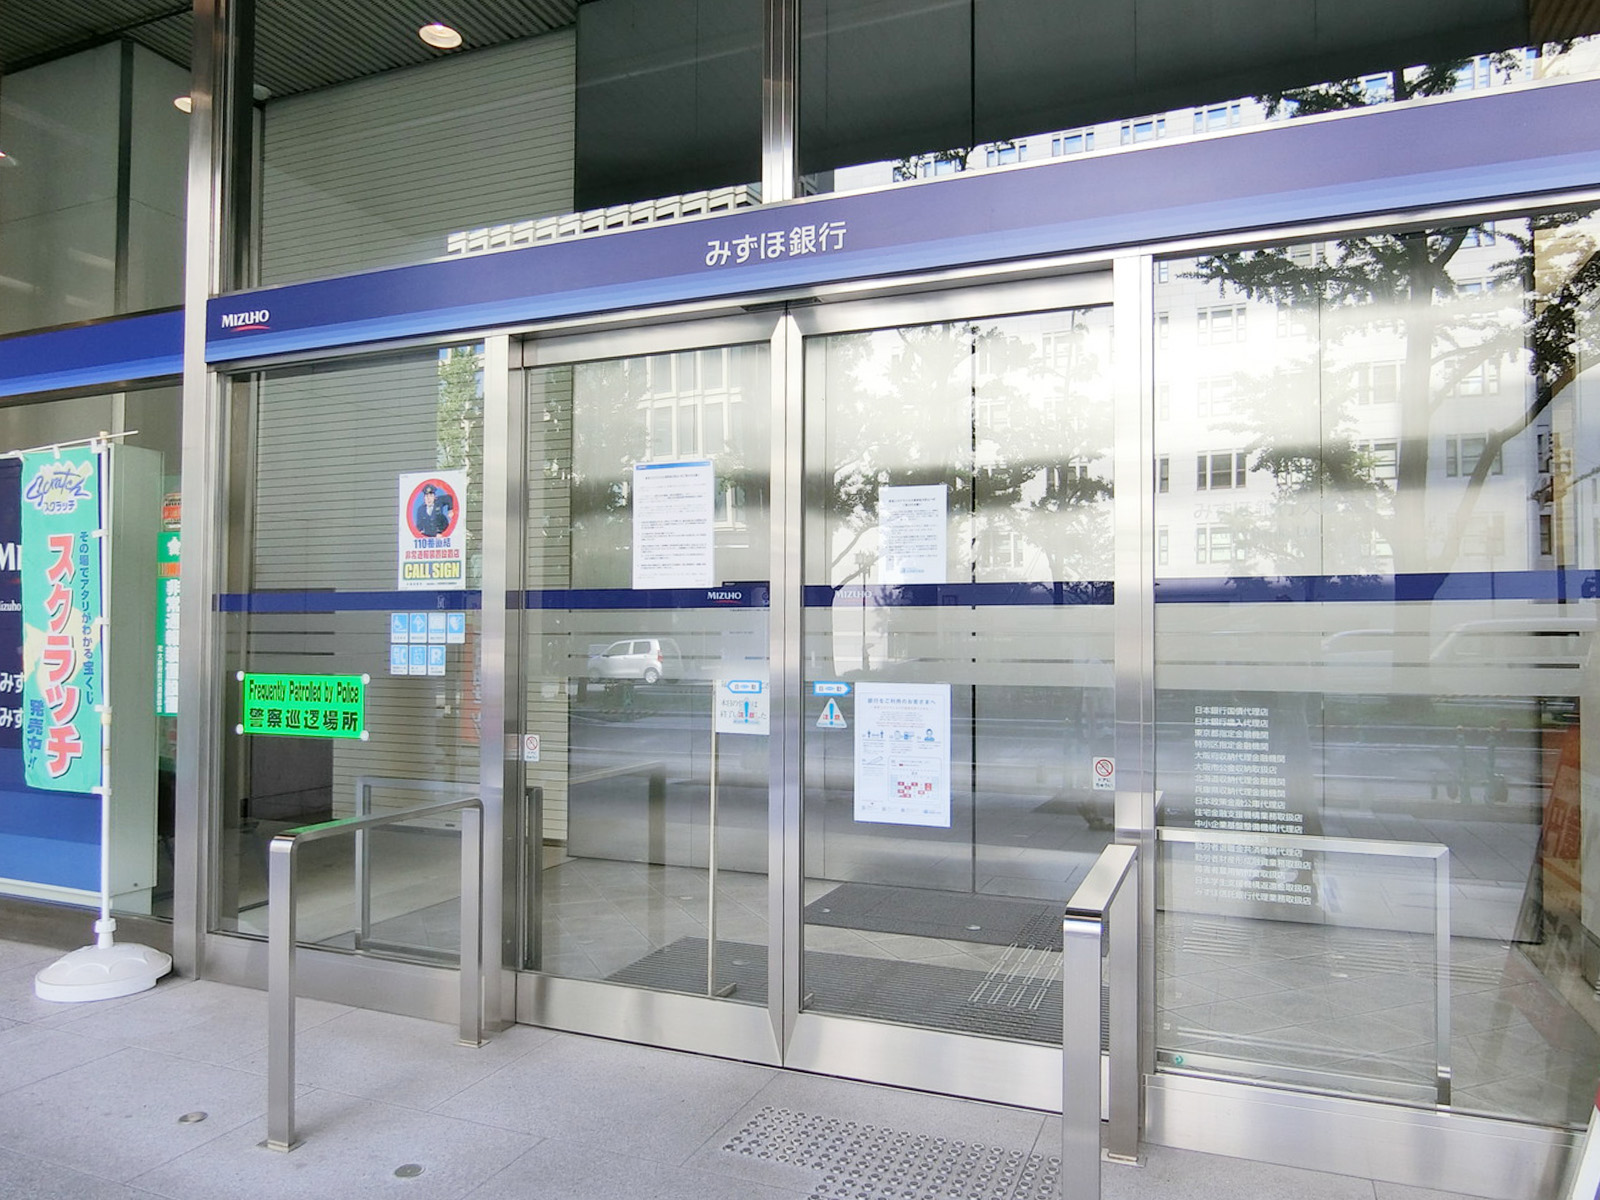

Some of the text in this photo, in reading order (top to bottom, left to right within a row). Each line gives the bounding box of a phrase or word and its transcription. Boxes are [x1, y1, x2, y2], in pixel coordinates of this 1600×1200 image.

[705, 221, 847, 266] みずほ銀行
[221, 309, 270, 328] MIZUHO
[44, 500, 75, 512] スクラッチ
[404, 561, 460, 579] CALL SIGN
[707, 591, 742, 600] MIZUHO
[835, 590, 873, 599] MIZUHO
[42, 533, 83, 779] スクラッチ
[249, 679, 360, 703] Frequently Patrolled by Police
